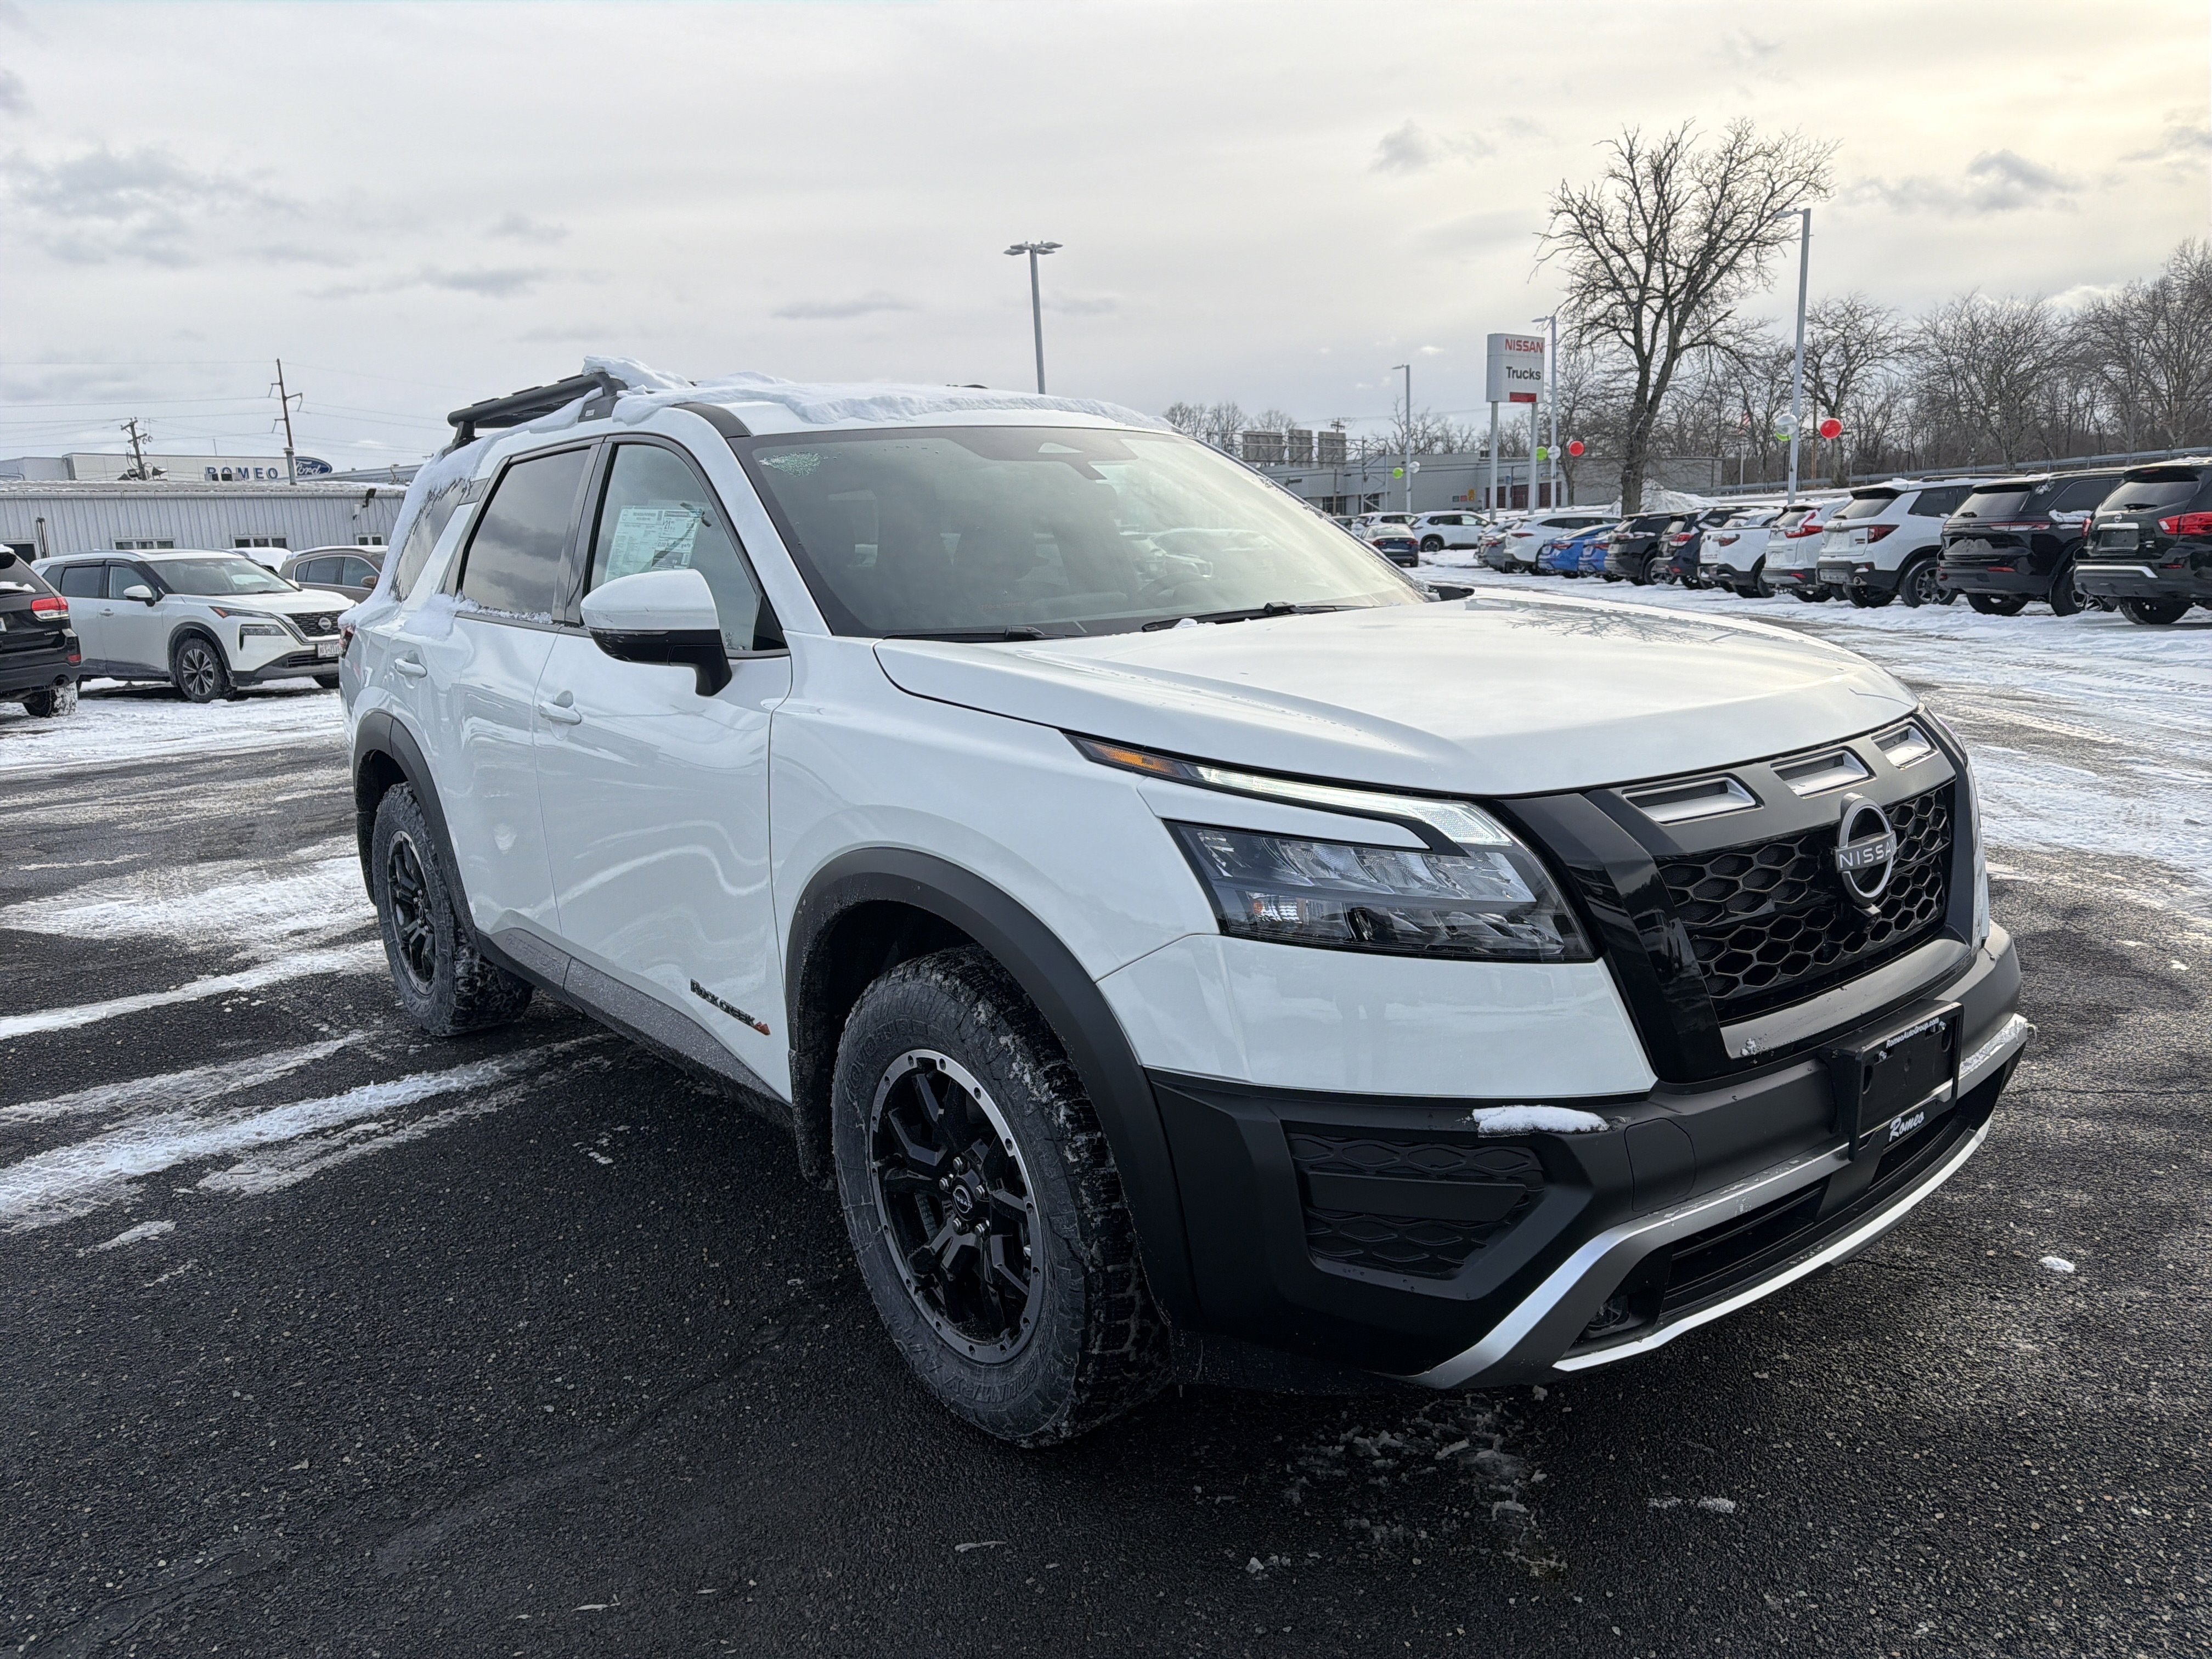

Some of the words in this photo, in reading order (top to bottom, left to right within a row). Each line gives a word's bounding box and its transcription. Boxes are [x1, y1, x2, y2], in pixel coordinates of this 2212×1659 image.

[1505, 338, 1544, 353] NISSAN
[1506, 366, 1541, 380] Trucks
[296, 461, 321, 475] Ford
[1839, 838, 1897, 868] NISSAN
[690, 978, 720, 1008] ROCK
[719, 998, 755, 1027] CREEK
[1886, 1017, 1939, 1049] RomeoAutoGroup.com
[1888, 1111, 1925, 1143] Romeo
